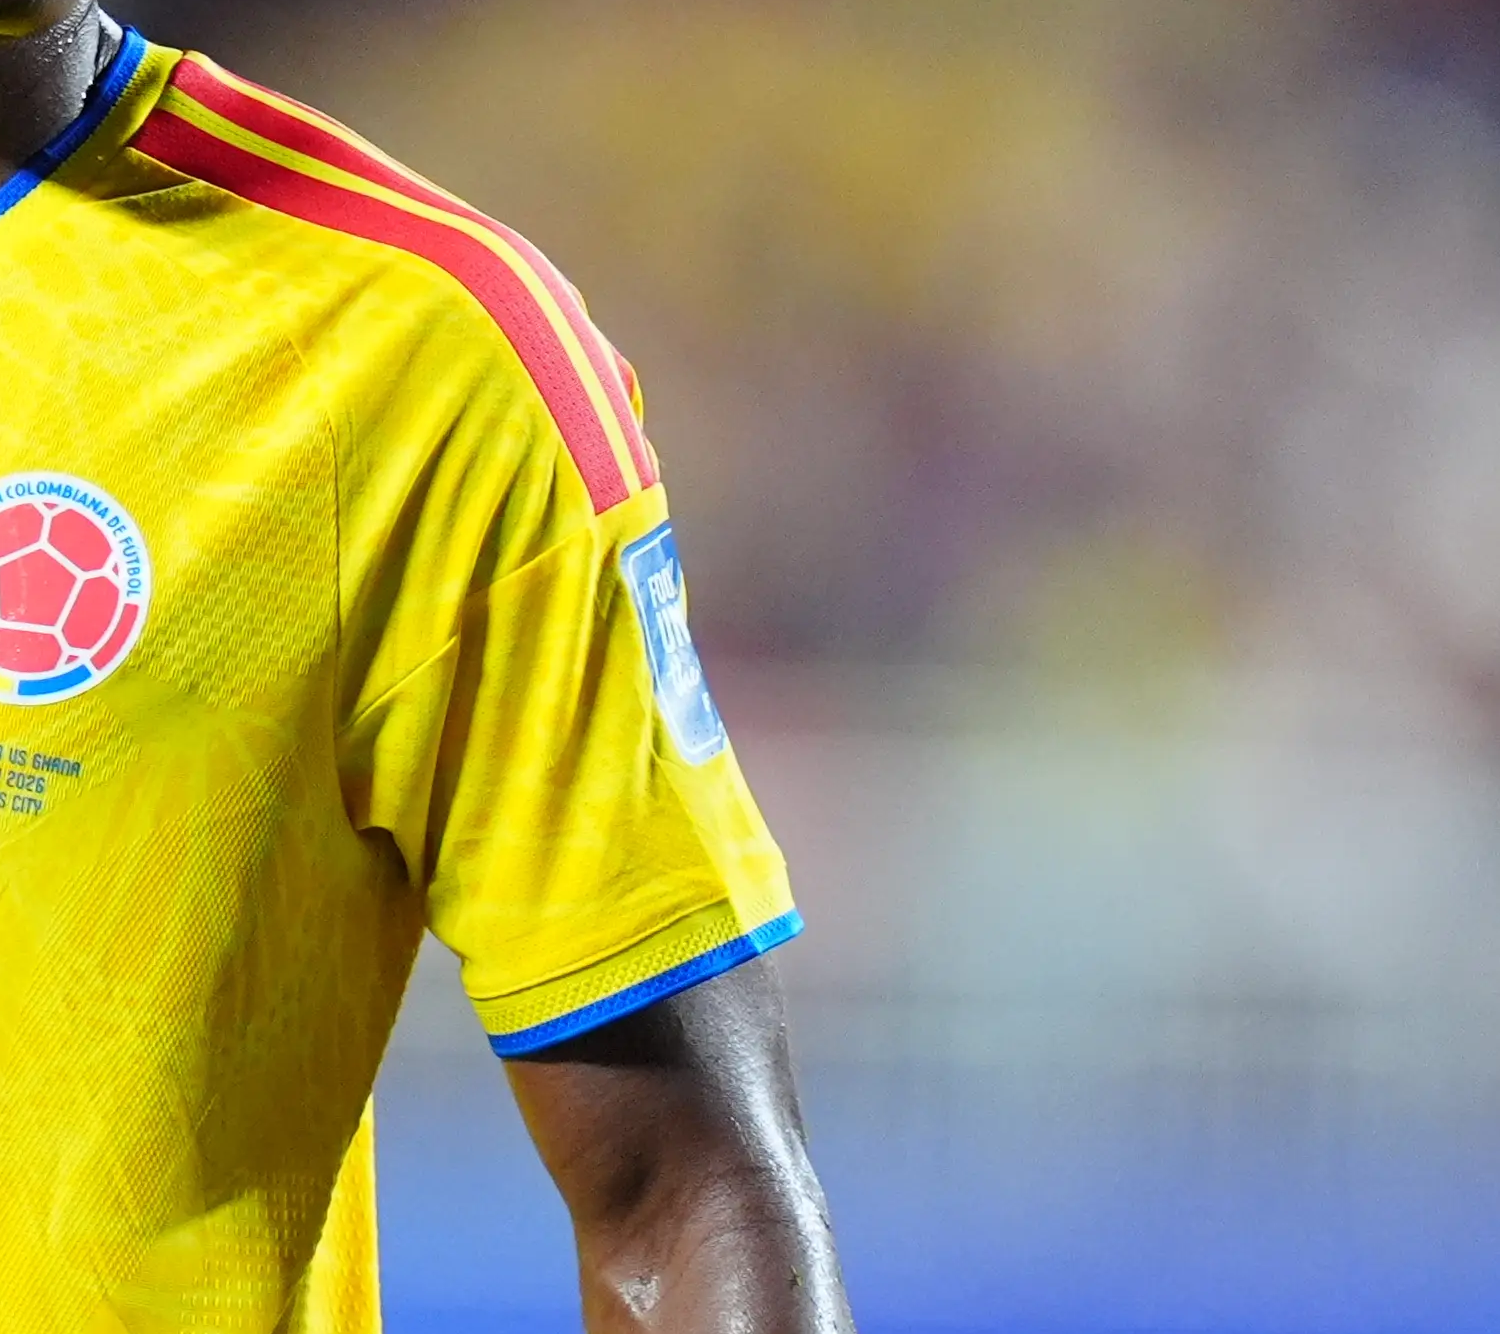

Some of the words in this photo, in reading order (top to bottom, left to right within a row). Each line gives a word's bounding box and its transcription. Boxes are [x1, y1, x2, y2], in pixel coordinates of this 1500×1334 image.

[6, 481, 109, 519] COLOMBIANA
[107, 516, 127, 537] DE
[33, 753, 81, 778] GHANA
[6, 770, 45, 794] 2026
[12, 795, 42, 816] CITY
